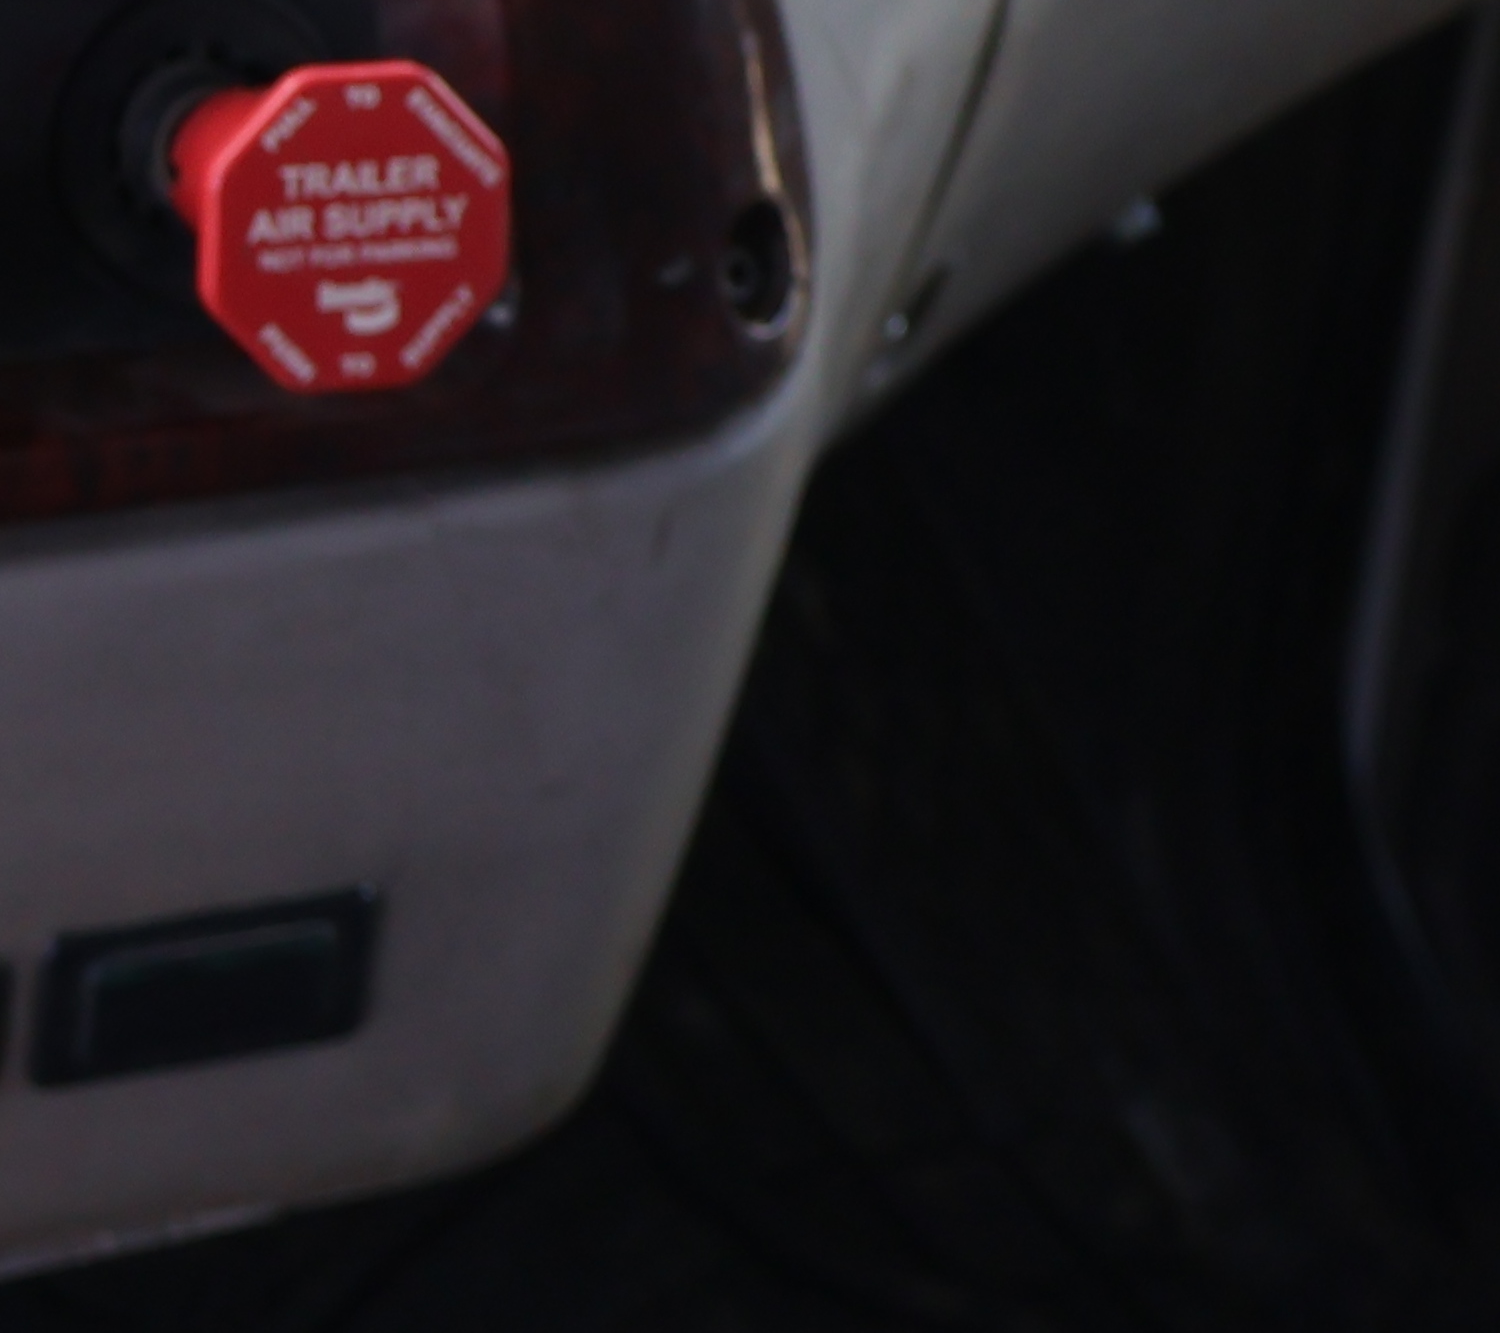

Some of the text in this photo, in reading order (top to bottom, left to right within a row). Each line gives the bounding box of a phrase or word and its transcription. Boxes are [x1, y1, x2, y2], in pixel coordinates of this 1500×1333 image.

[279, 154, 440, 200] TRAILER
[247, 193, 469, 246] AIR SUPPLY
[308, 241, 354, 269] FOR
